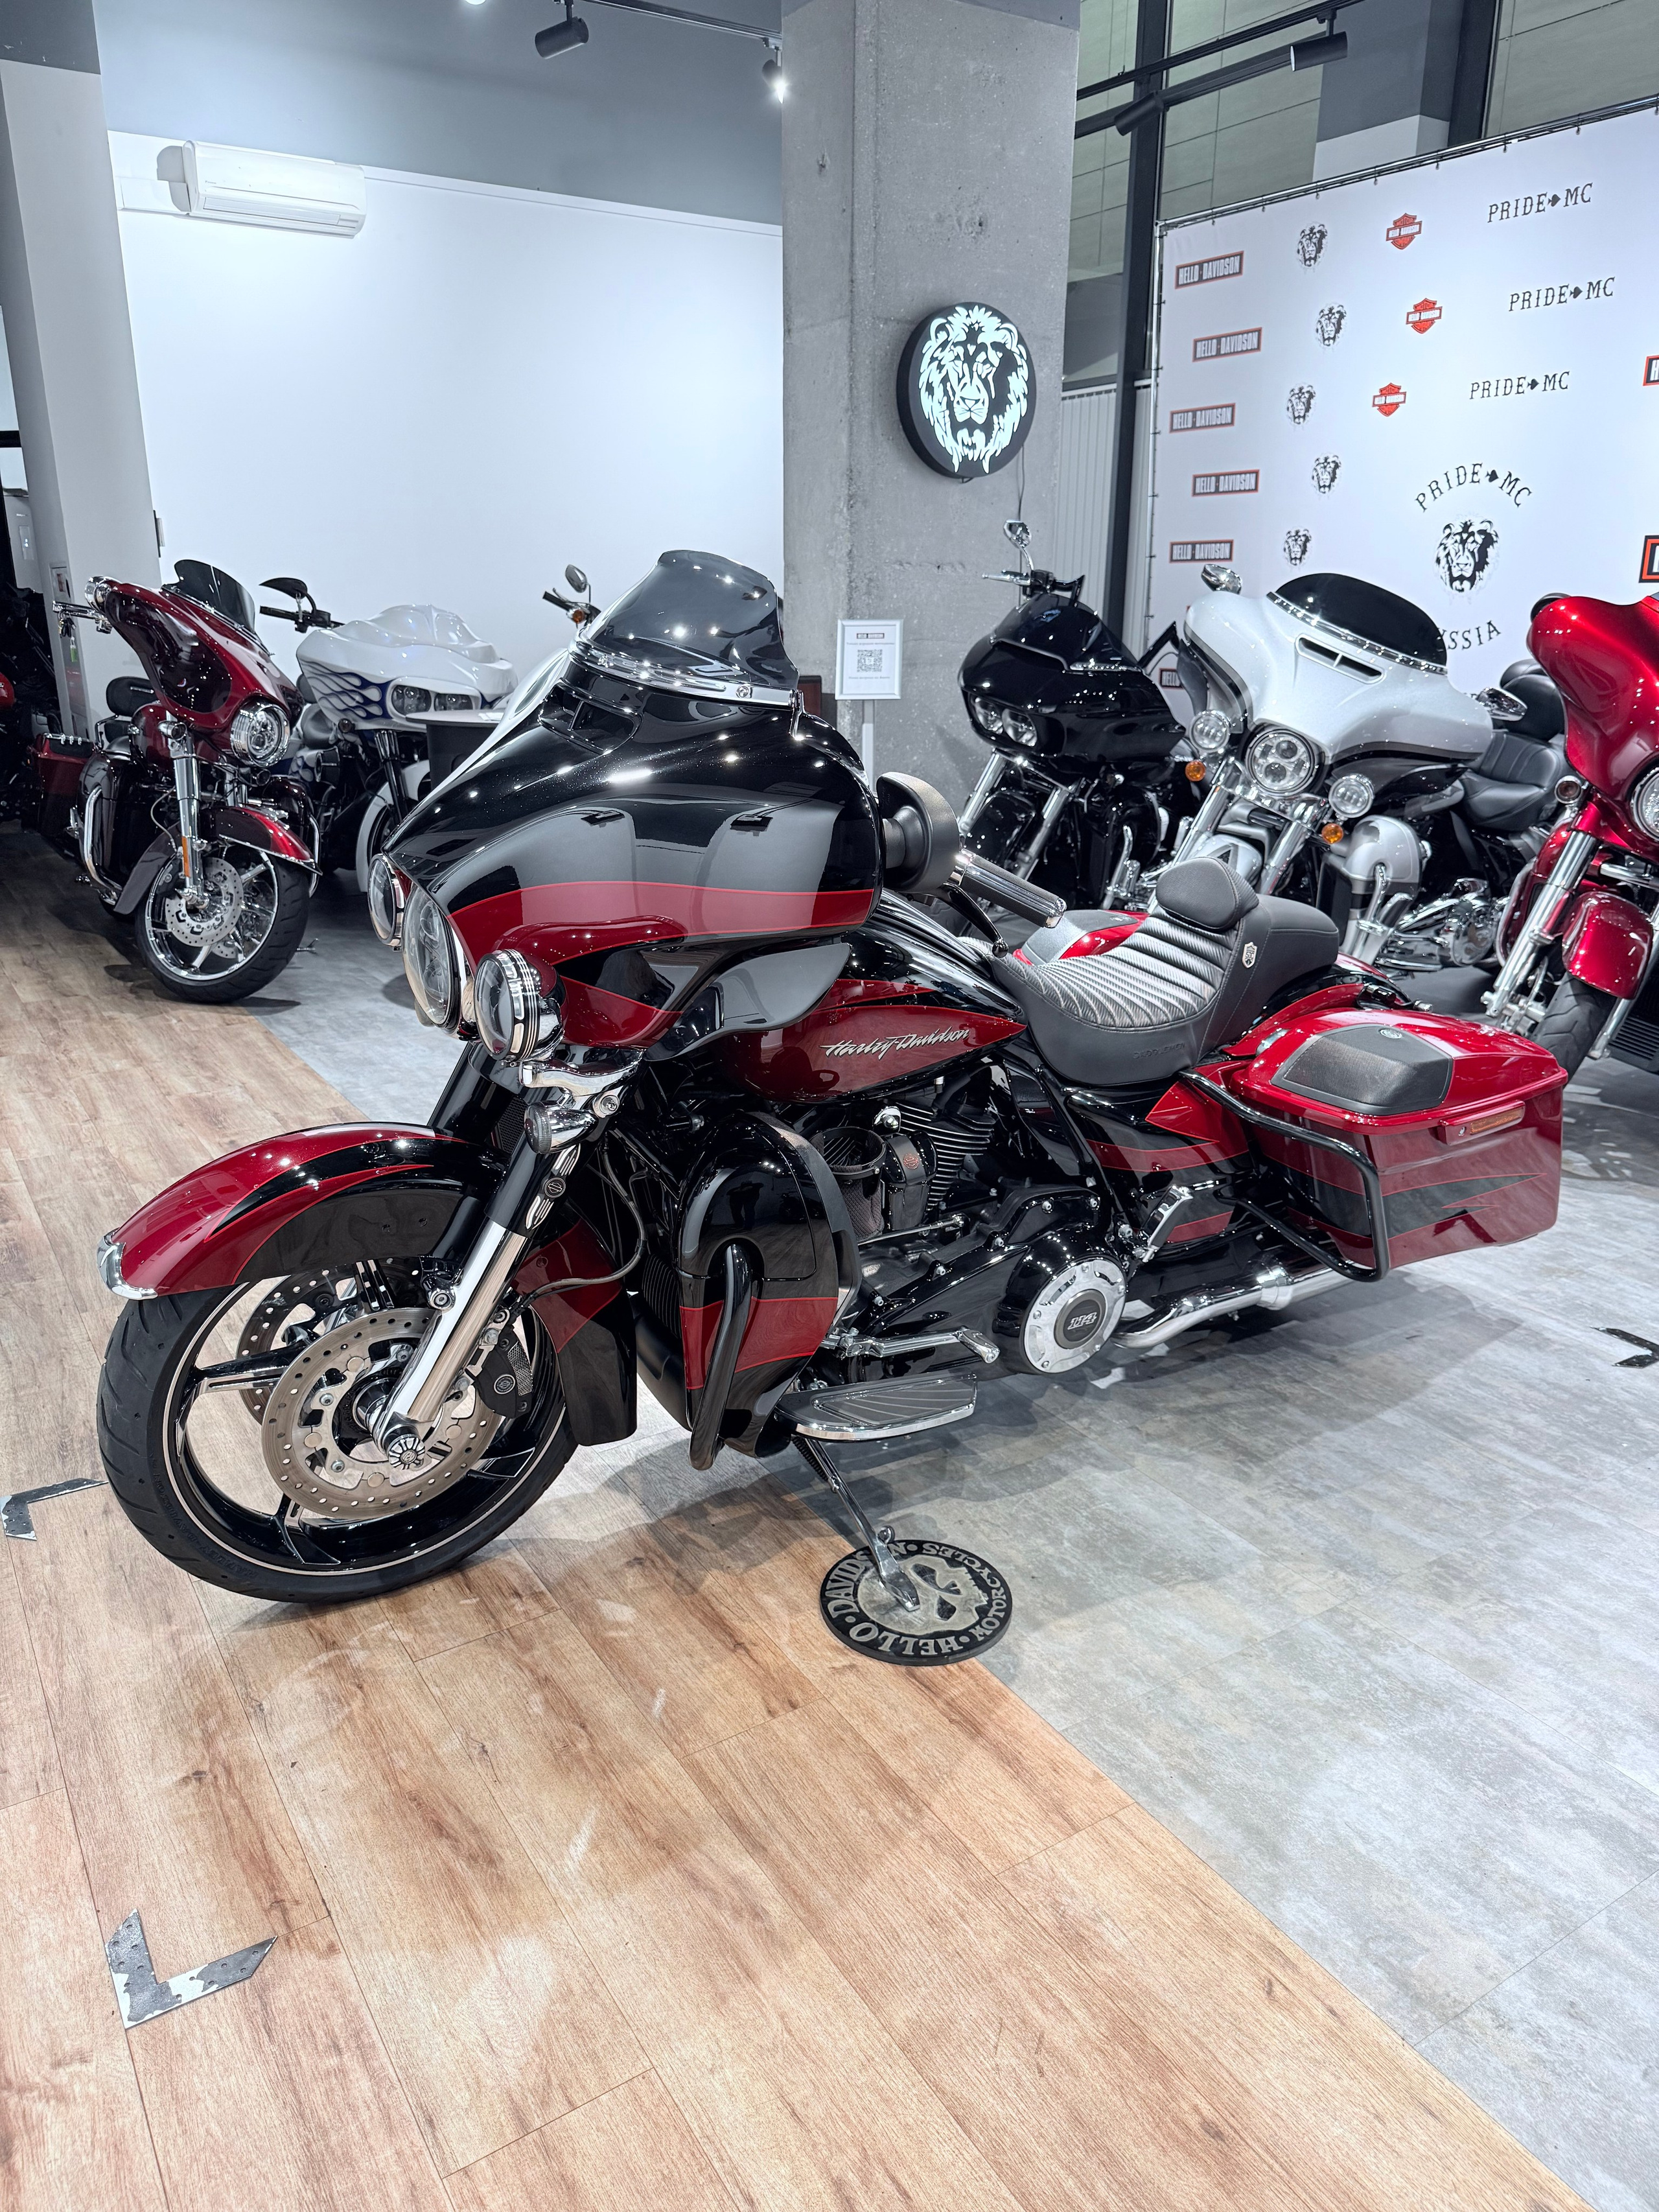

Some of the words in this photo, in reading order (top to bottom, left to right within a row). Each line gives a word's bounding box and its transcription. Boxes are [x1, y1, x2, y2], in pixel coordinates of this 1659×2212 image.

[1487, 192, 1548, 223] PRIDE
[1563, 182, 1593, 207] MC
[1179, 265, 1199, 285] HELLO
[1203, 255, 1240, 280] DAVIDSON
[1509, 283, 1570, 312] PRIDE
[1584, 276, 1616, 299] MC
[1196, 339, 1217, 358] HELLO
[1220, 331, 1259, 354] DAVIDSON
[1469, 376, 1527, 400] PRIDE
[1542, 371, 1570, 392] MC
[1172, 412, 1193, 430] HELLO
[1196, 406, 1232, 427] DAVIDSON
[1195, 476, 1216, 494] HELLO
[1219, 473, 1257, 492] DAVIDSON
[1415, 462, 1483, 513] PRIDE
[1498, 471, 1533, 508] MC
[1172, 544, 1192, 560] HELLO
[1194, 542, 1231, 560] DAVIDSON
[820, 1026, 970, 1060] Harley-Davidson
[1067, 1312, 1097, 1330] 114
[825, 1543, 907, 1618] DAVIDSN
[922, 1543, 1006, 1641] MOTORCYCLES
[849, 1622, 964, 1655] HELLO
